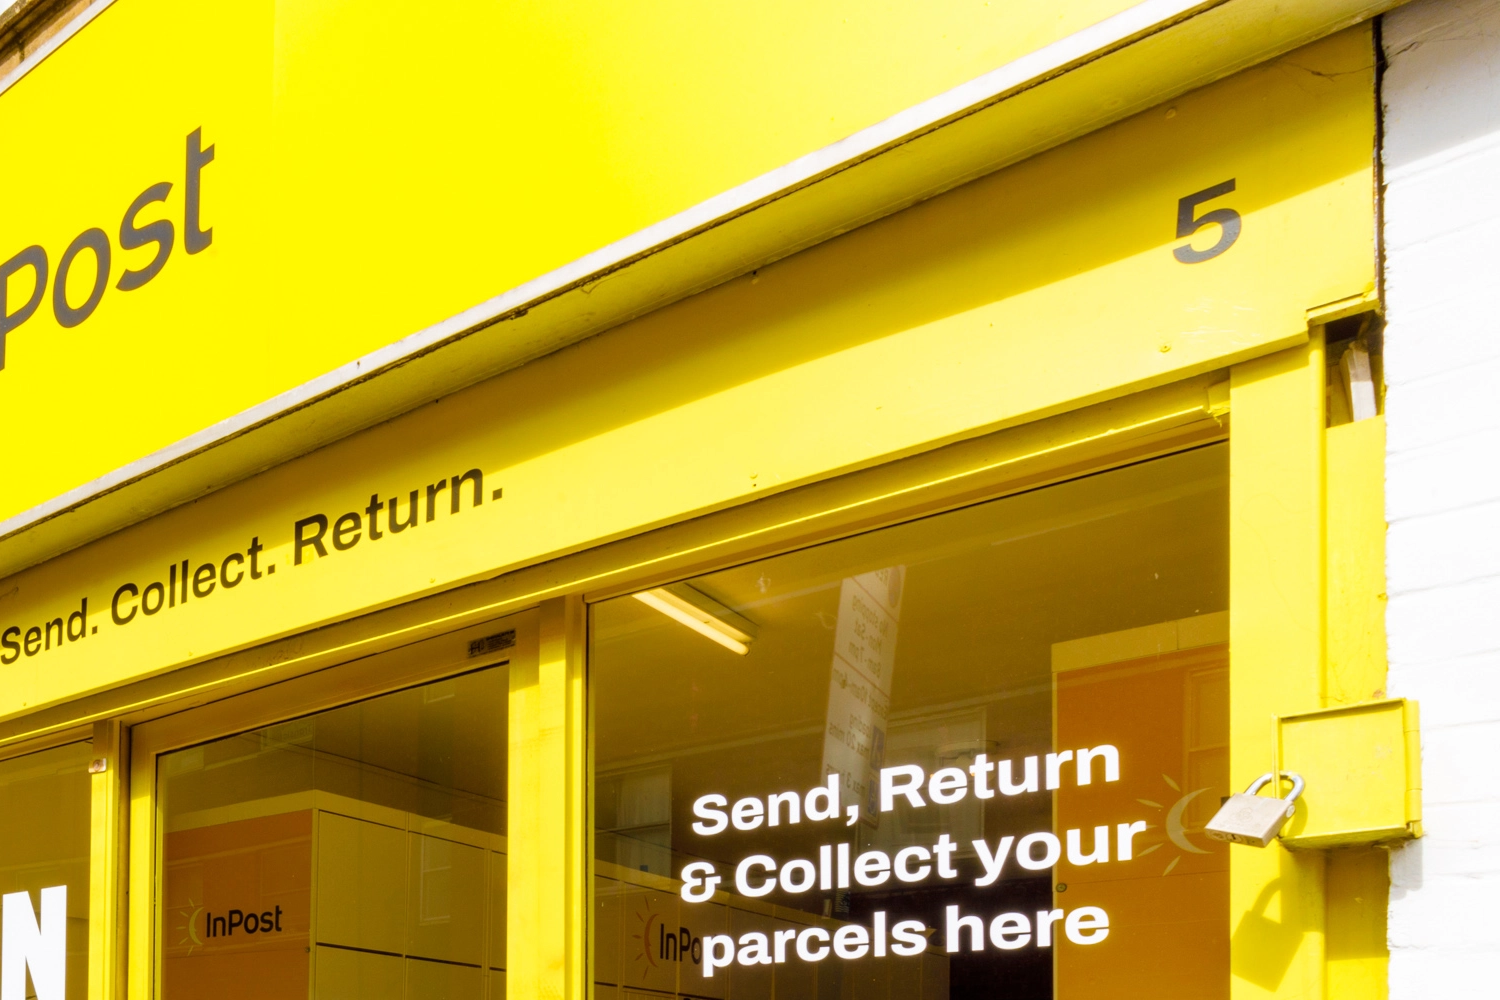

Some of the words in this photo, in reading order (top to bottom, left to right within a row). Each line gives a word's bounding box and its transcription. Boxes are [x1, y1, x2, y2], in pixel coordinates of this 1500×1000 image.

[1173, 178, 1242, 264] 5
[0, 597, 98, 665] Send.
[111, 537, 276, 626] Collect.
[294, 468, 504, 567] Return.
[692, 773, 859, 836] Send,
[879, 744, 1120, 812] Return
[680, 862, 722, 903] &
[735, 833, 958, 897] Collect
[971, 820, 1147, 887] your
[206, 905, 283, 938] InPost
[702, 910, 926, 978] parcels
[945, 904, 1110, 953] here
